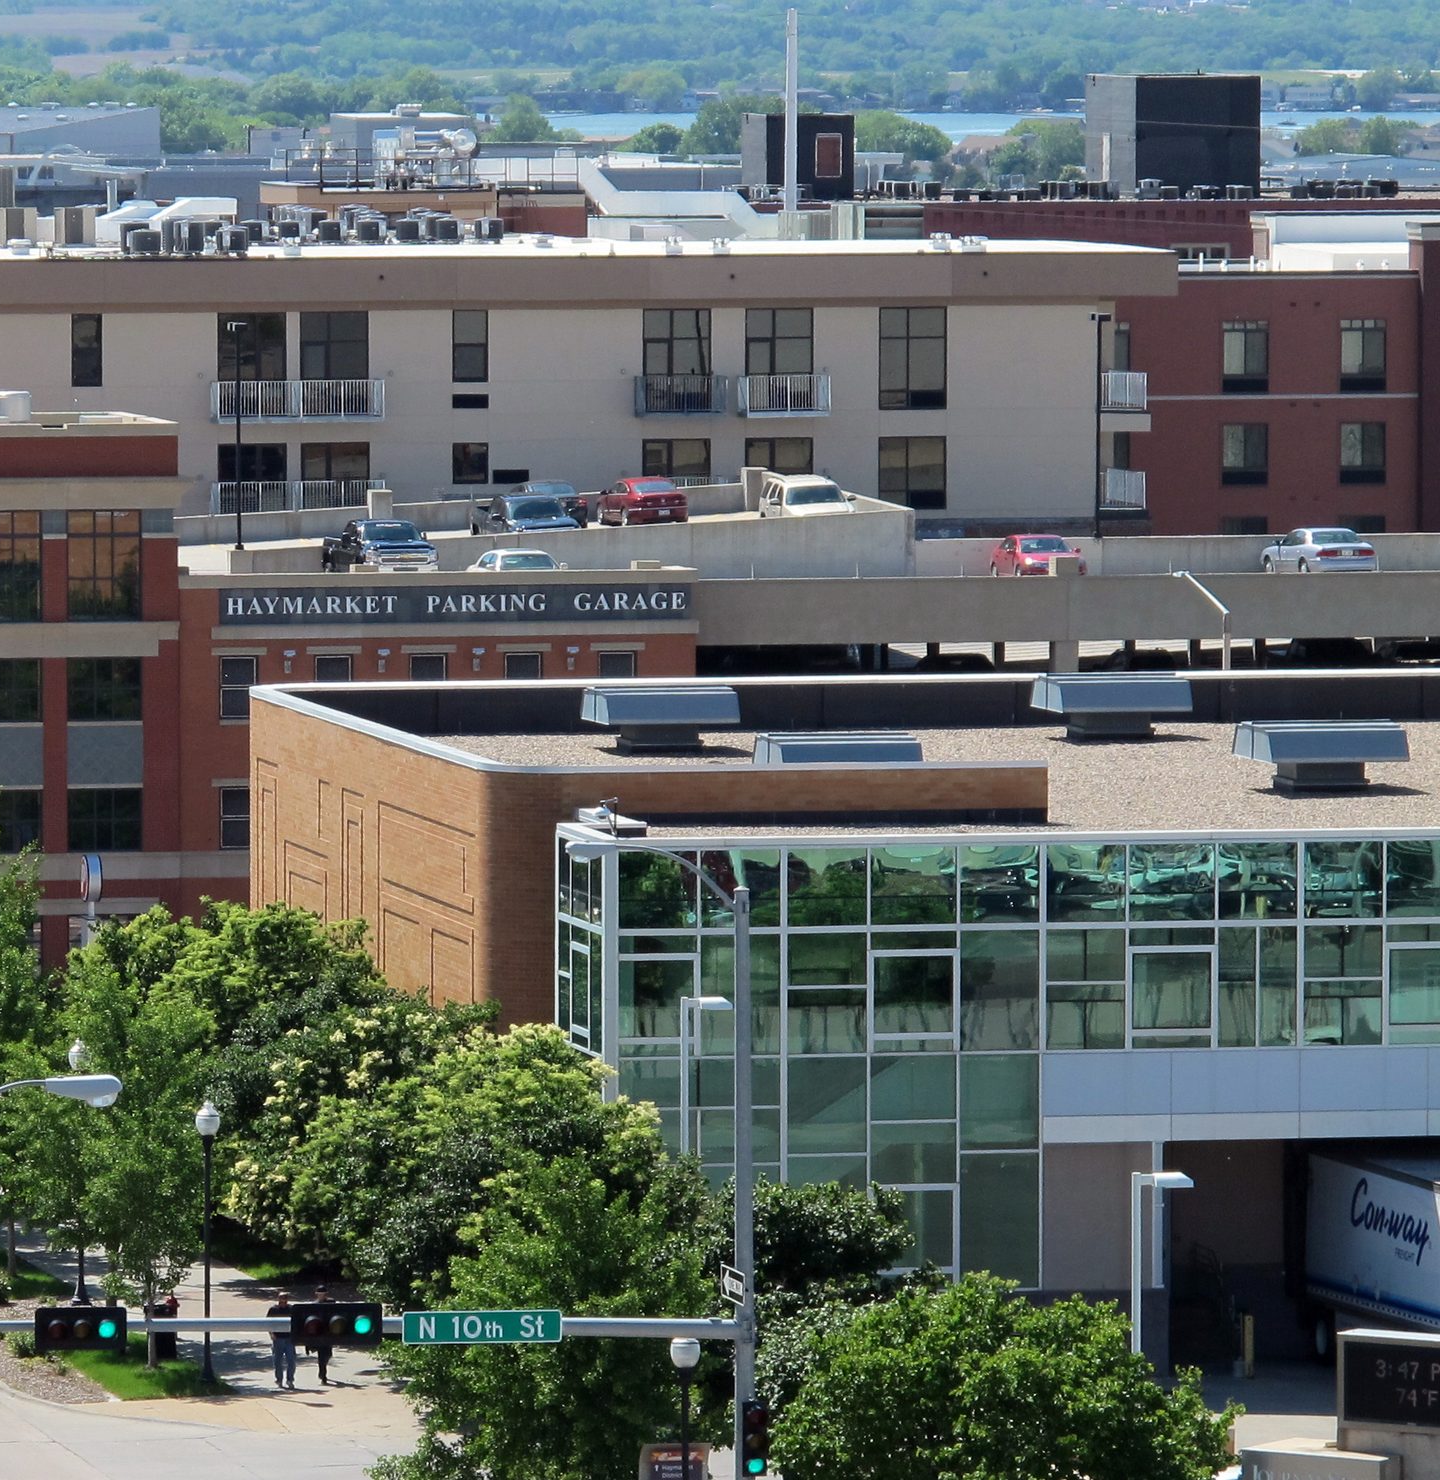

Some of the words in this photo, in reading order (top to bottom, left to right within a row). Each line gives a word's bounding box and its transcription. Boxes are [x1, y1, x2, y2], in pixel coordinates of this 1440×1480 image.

[225, 594, 398, 615] HAYMARKET
[426, 593, 547, 613] PARKING
[573, 591, 687, 611] GARAGE
[419, 1316, 436, 1339] N
[451, 1315, 503, 1339] 10th
[519, 1314, 545, 1338] St
[1375, 1359, 1420, 1380] 3:47
